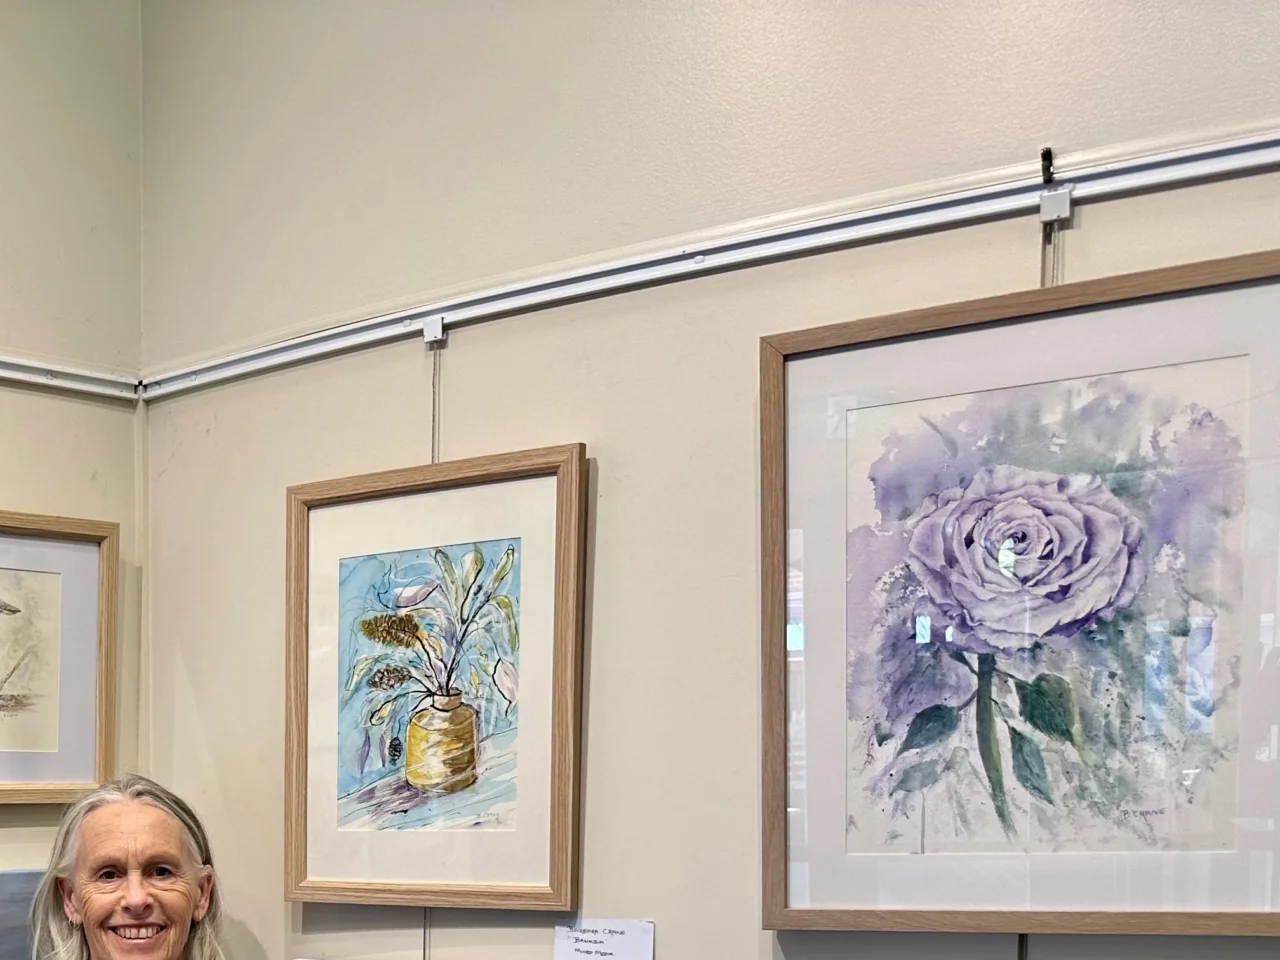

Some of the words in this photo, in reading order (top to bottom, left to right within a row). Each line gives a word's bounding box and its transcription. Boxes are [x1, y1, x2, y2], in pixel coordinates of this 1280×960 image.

[1133, 807, 1166, 818] CRANE
[602, 928, 626, 937] CRANE
[574, 947, 593, 955] MIXED
